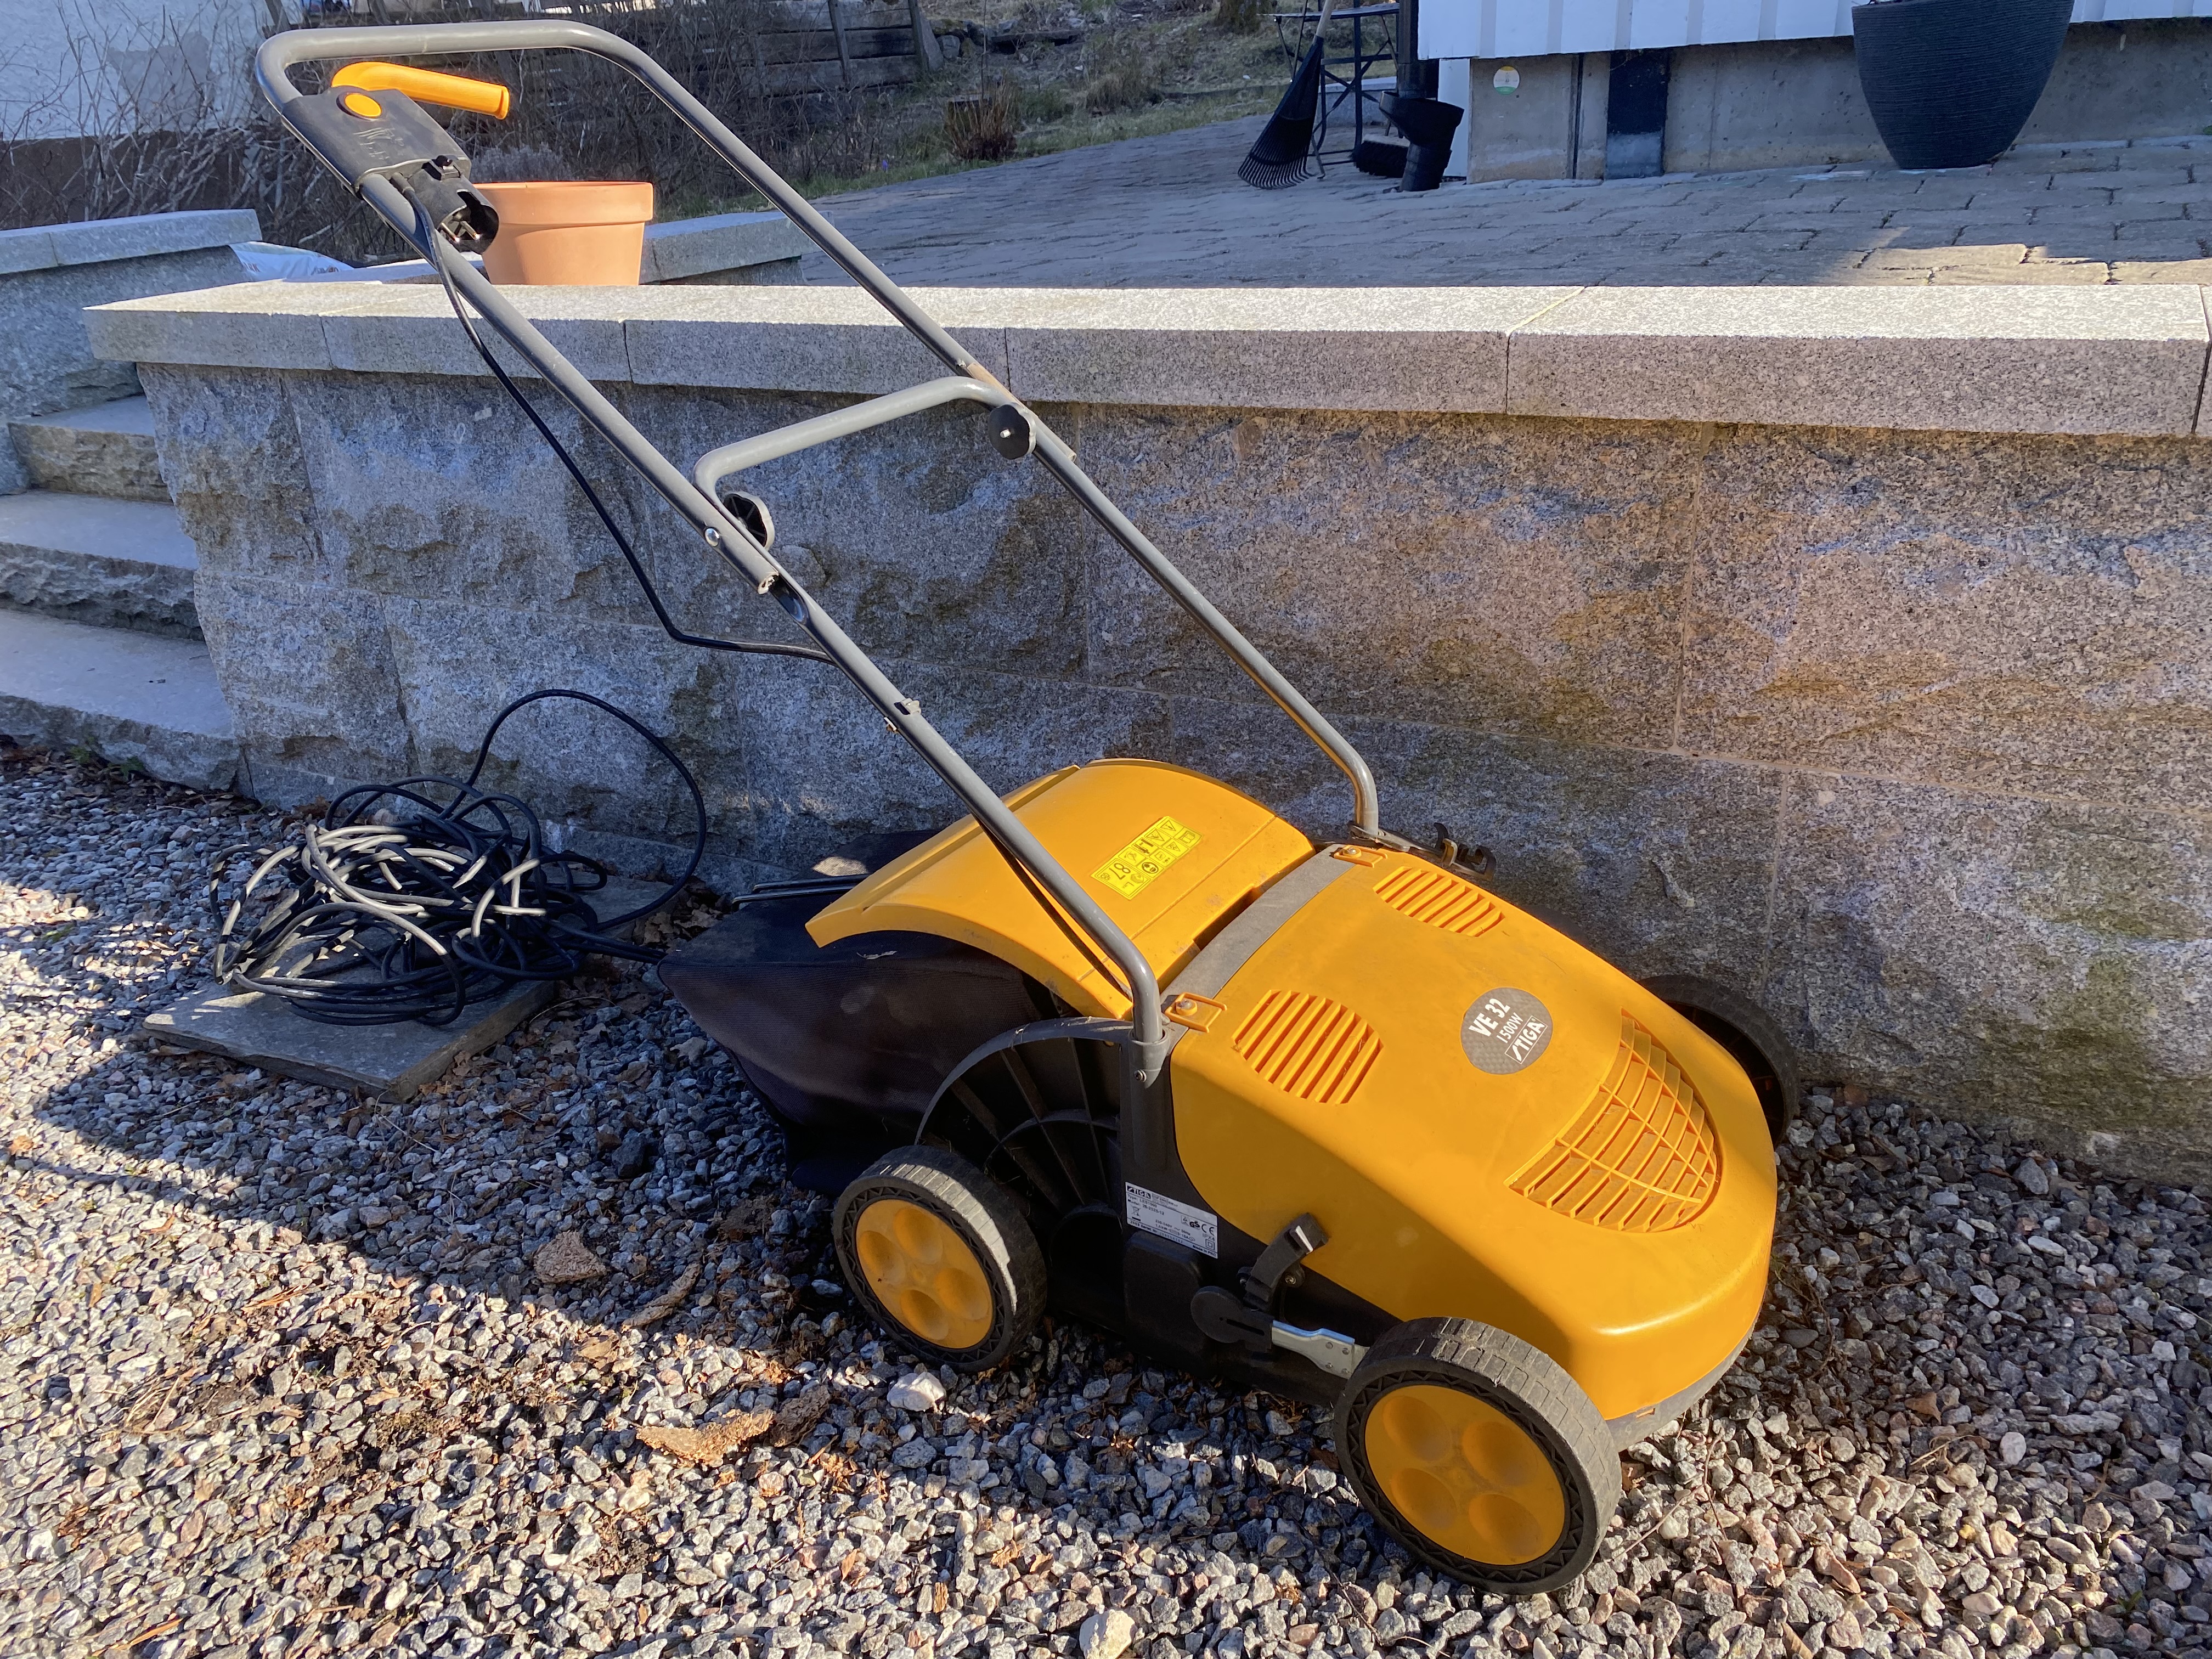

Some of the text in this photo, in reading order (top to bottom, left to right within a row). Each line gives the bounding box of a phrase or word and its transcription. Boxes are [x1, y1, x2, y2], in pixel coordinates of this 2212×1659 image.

[1109, 862, 1131, 880] 87
[1468, 998, 1511, 1037] VE 32
[1496, 1012, 1523, 1043] 1500W
[1512, 1022, 1545, 1062] STIGA
[1127, 1186, 1151, 1199] STIGA
[1201, 1224, 1215, 1236] CE
[1203, 1233, 1215, 1242] IPX4
